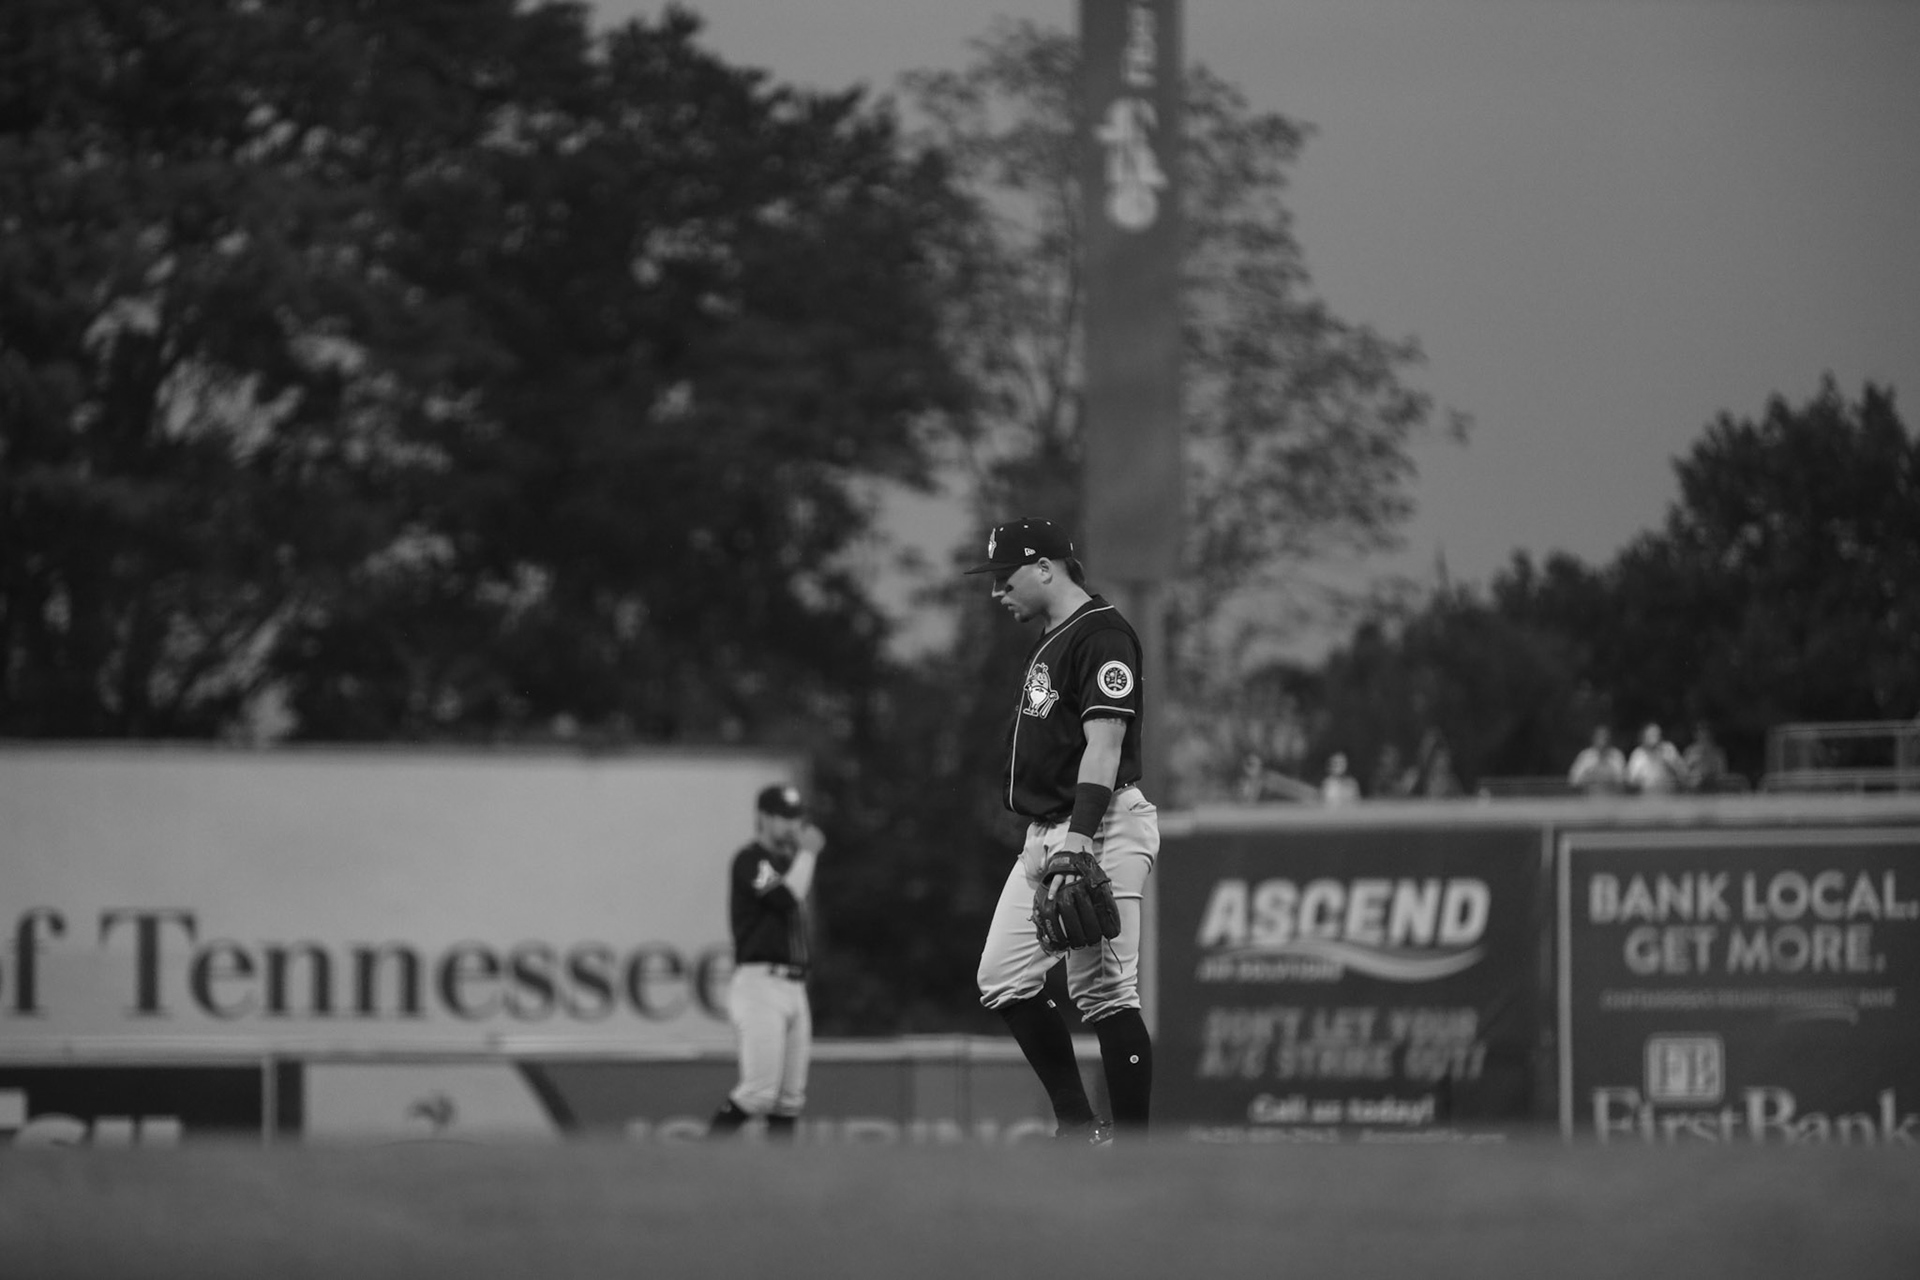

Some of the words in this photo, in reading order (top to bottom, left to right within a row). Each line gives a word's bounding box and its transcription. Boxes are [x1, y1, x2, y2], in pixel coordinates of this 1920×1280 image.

[1196, 876, 1491, 948] ASCEND
[1590, 871, 1731, 924] BANK
[1742, 868, 1919, 922] LOCAL.
[0, 905, 67, 1021] f
[1622, 923, 1719, 976] GET
[1726, 923, 1888, 976] MORE.
[1249, 1092, 1308, 1123] Call
